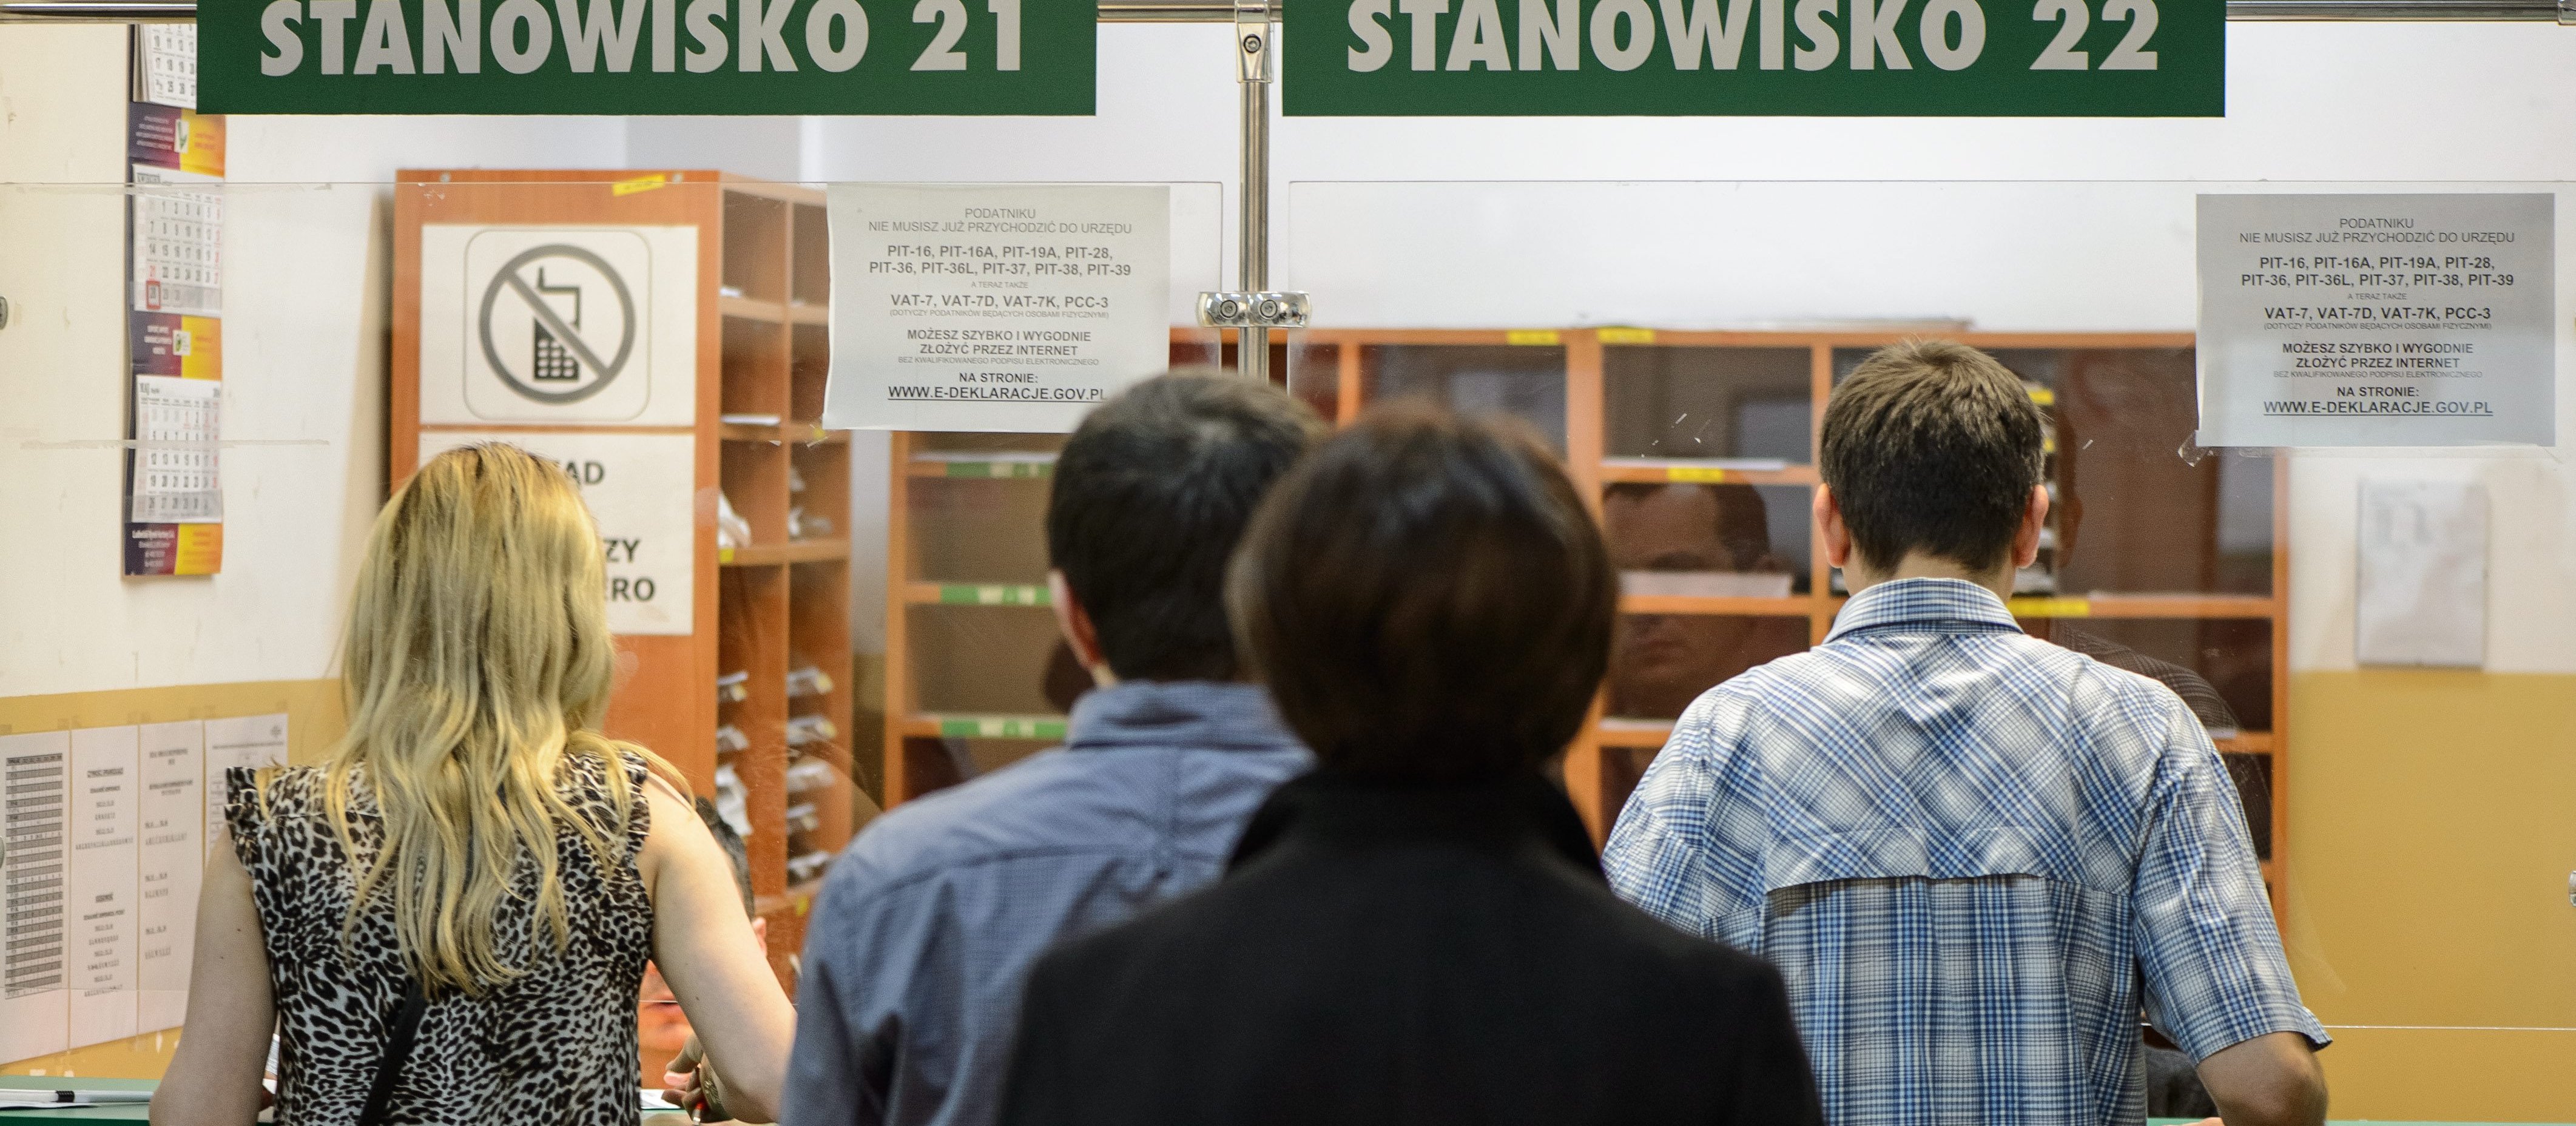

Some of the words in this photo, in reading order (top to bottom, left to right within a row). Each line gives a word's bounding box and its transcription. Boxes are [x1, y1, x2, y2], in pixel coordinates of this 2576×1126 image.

[261, 0, 869, 76] STANOWISKO
[910, 0, 1020, 71] 21
[1347, 0, 1986, 72] STANOWISKO
[2029, 0, 2159, 70] 22
[965, 207, 1036, 219] PODATNIKU
[868, 221, 889, 232] NIE
[892, 221, 939, 232] MUSISZ
[941, 220, 965, 232] JUŻ
[967, 220, 1056, 234] PRZYCHODZIĆ
[1059, 222, 1078, 234] DO
[1081, 223, 1132, 237] URZĘDU
[2339, 217, 2414, 229] PODATNIKU
[2239, 232, 2261, 243] NIE
[2264, 232, 2313, 243] MUSISZ
[2315, 231, 2340, 243] JUŻ
[2342, 230, 2435, 243] PRZYCHODZIĆ
[2438, 232, 2458, 243] DO
[2461, 232, 2515, 246] URZĘDU
[888, 244, 935, 258] PIT-16,
[939, 245, 998, 259] PIT-16A,
[1002, 246, 1060, 260] PIT-19A,
[1065, 246, 1113, 261] PIT-28,
[869, 261, 917, 275] PIT-36,
[921, 261, 978, 275] PIT-36L,
[983, 262, 1030, 276] PIT-37,
[1035, 263, 1082, 277] PIT-38,
[1087, 263, 1131, 276] PIT-39
[2260, 257, 2309, 270] PIT-16,
[2314, 257, 2375, 270] PIT-16A,
[2379, 256, 2440, 269] PIT-19A,
[2445, 256, 2495, 270] PIT-28,
[1004, 281, 1028, 289] TAKŻE
[2241, 274, 2291, 287] PIT-36,
[2295, 274, 2355, 287] PIT-36L,
[2359, 274, 2409, 287] PIT-37,
[2413, 274, 2463, 288] PIT-38,
[2468, 274, 2514, 286] PIT-39
[891, 294, 937, 308] VAT-7,
[941, 294, 999, 308] VAT-7D,
[1002, 295, 1060, 309] VAT-7K,
[1065, 295, 1108, 308] PCC-3
[2355, 292, 2381, 301] TERAZ
[2382, 292, 2407, 301] TAKŻE
[2264, 307, 2313, 321] VAT-7,
[2317, 307, 2376, 320] VAT-7D,
[2381, 307, 2440, 320] VAT-7K,
[2445, 307, 2491, 320] PCC-3
[907, 327, 959, 341] MOŻESZ
[962, 329, 1013, 341] SZYBKO
[1016, 331, 1020, 341] I
[1022, 331, 1091, 342] WYGODNIE
[919, 342, 969, 355] ZŁOŻYĆ
[973, 344, 1013, 355] PRZEZ
[1016, 345, 1078, 356] INTERNET
[2282, 340, 2336, 354] MOŻESZ
[2339, 343, 2392, 354] SZYBKO
[2395, 343, 2399, 353] I
[2402, 343, 2473, 354] WYGODNIE
[2296, 354, 2347, 368] ZŁOŻYĆ
[2351, 357, 2393, 368] PRZEZ
[2396, 357, 2460, 368] INTERNET
[959, 373, 977, 382] NA
[980, 373, 1037, 383] STRONIE:
[2337, 386, 2355, 397] NA
[2359, 386, 2419, 397] STRONIE:
[2264, 401, 2493, 414] WWW.E-DEKLARACJE.GOV.PL
[564, 460, 605, 485] AD
